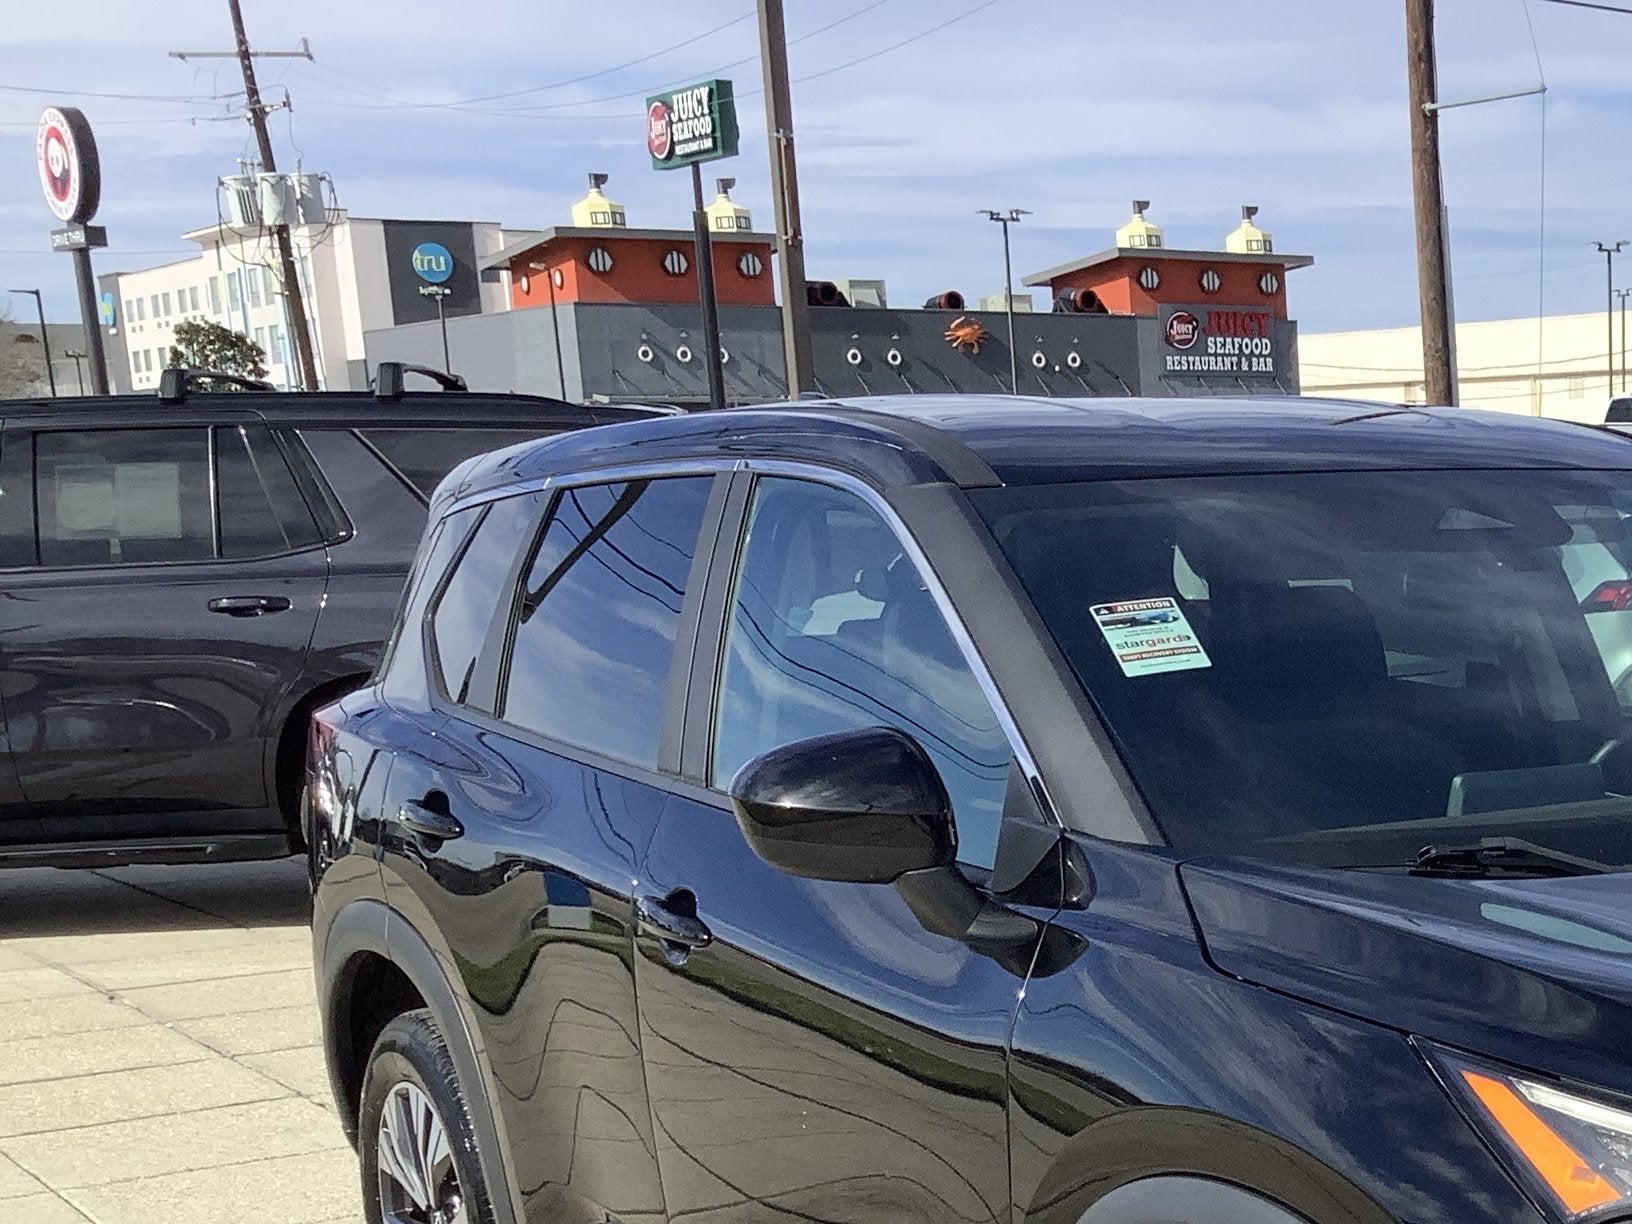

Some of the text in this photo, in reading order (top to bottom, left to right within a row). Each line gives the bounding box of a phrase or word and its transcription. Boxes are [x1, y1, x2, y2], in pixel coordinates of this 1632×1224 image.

[670, 86, 709, 122] JUICY
[672, 115, 712, 142] SEAFOOD
[415, 250, 446, 272] tru
[1203, 310, 1269, 337] JUICY
[1207, 337, 1271, 355] SEAFOOD
[1166, 355, 1274, 371] RESTAURANT & BAR
[1117, 601, 1171, 613] ATTENTION
